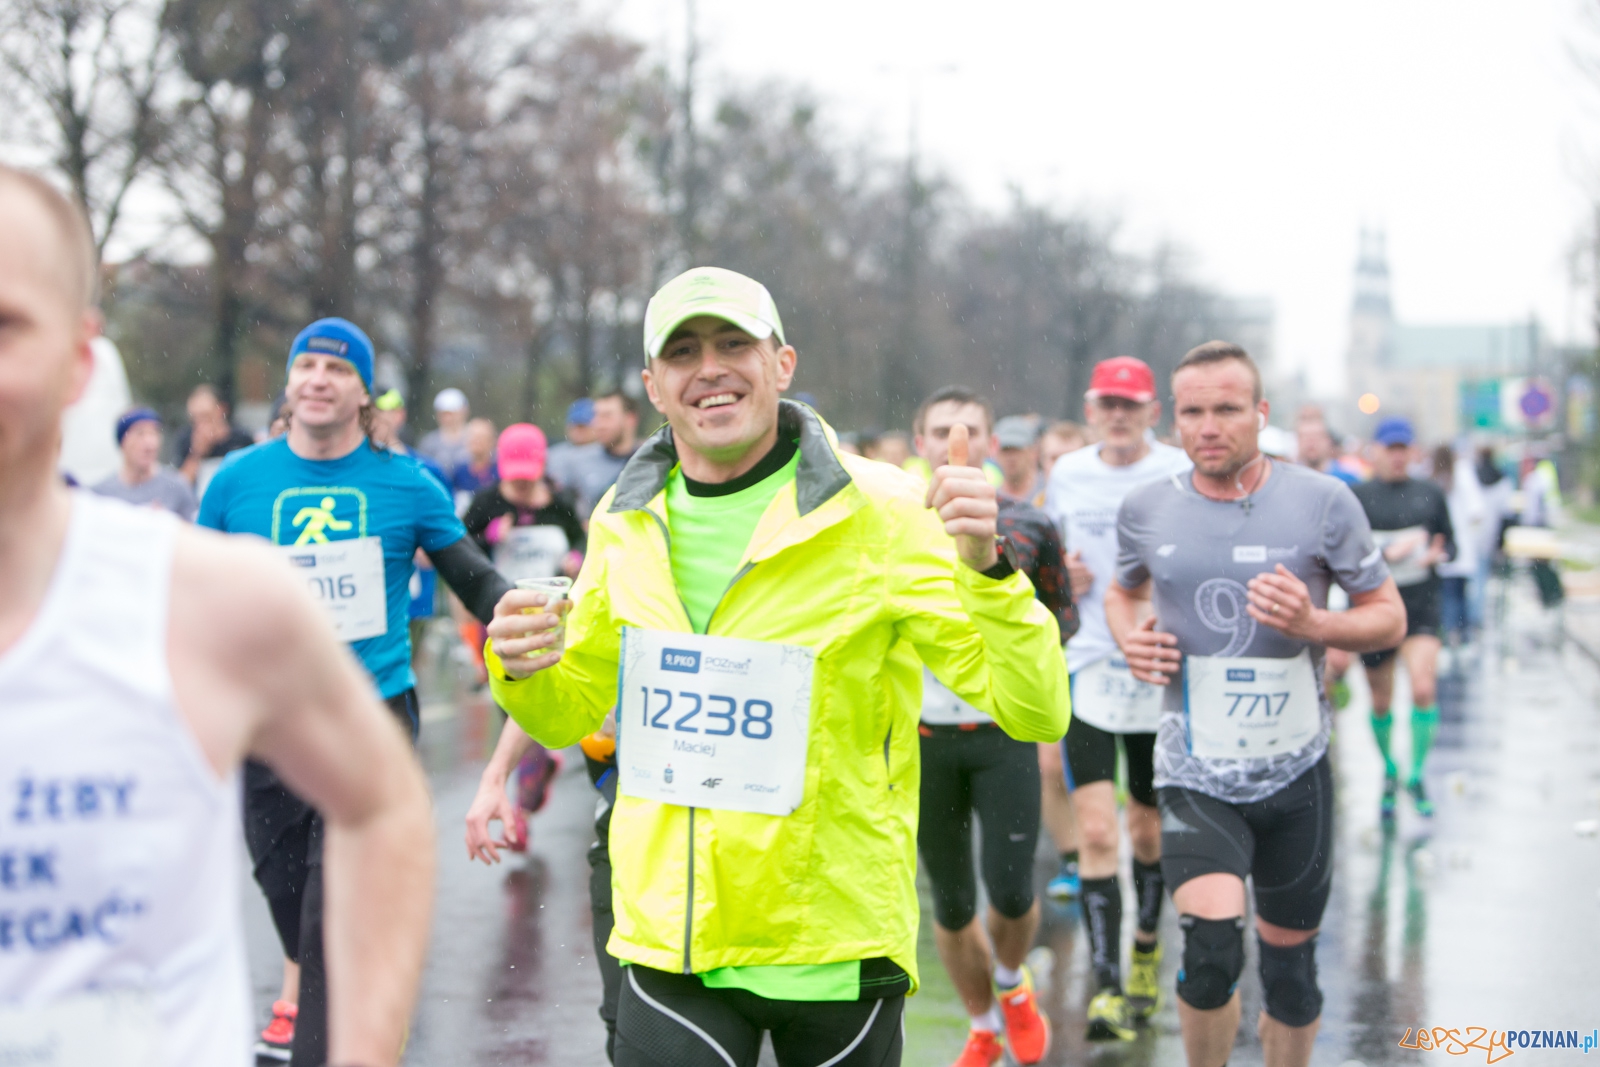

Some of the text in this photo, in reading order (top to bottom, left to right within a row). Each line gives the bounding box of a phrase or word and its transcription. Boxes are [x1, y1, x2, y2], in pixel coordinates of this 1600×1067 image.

[1194, 577, 1257, 658] 9
[641, 686, 773, 740] 12238
[1225, 691, 1290, 717] 7717
[673, 739, 717, 757] Maciej
